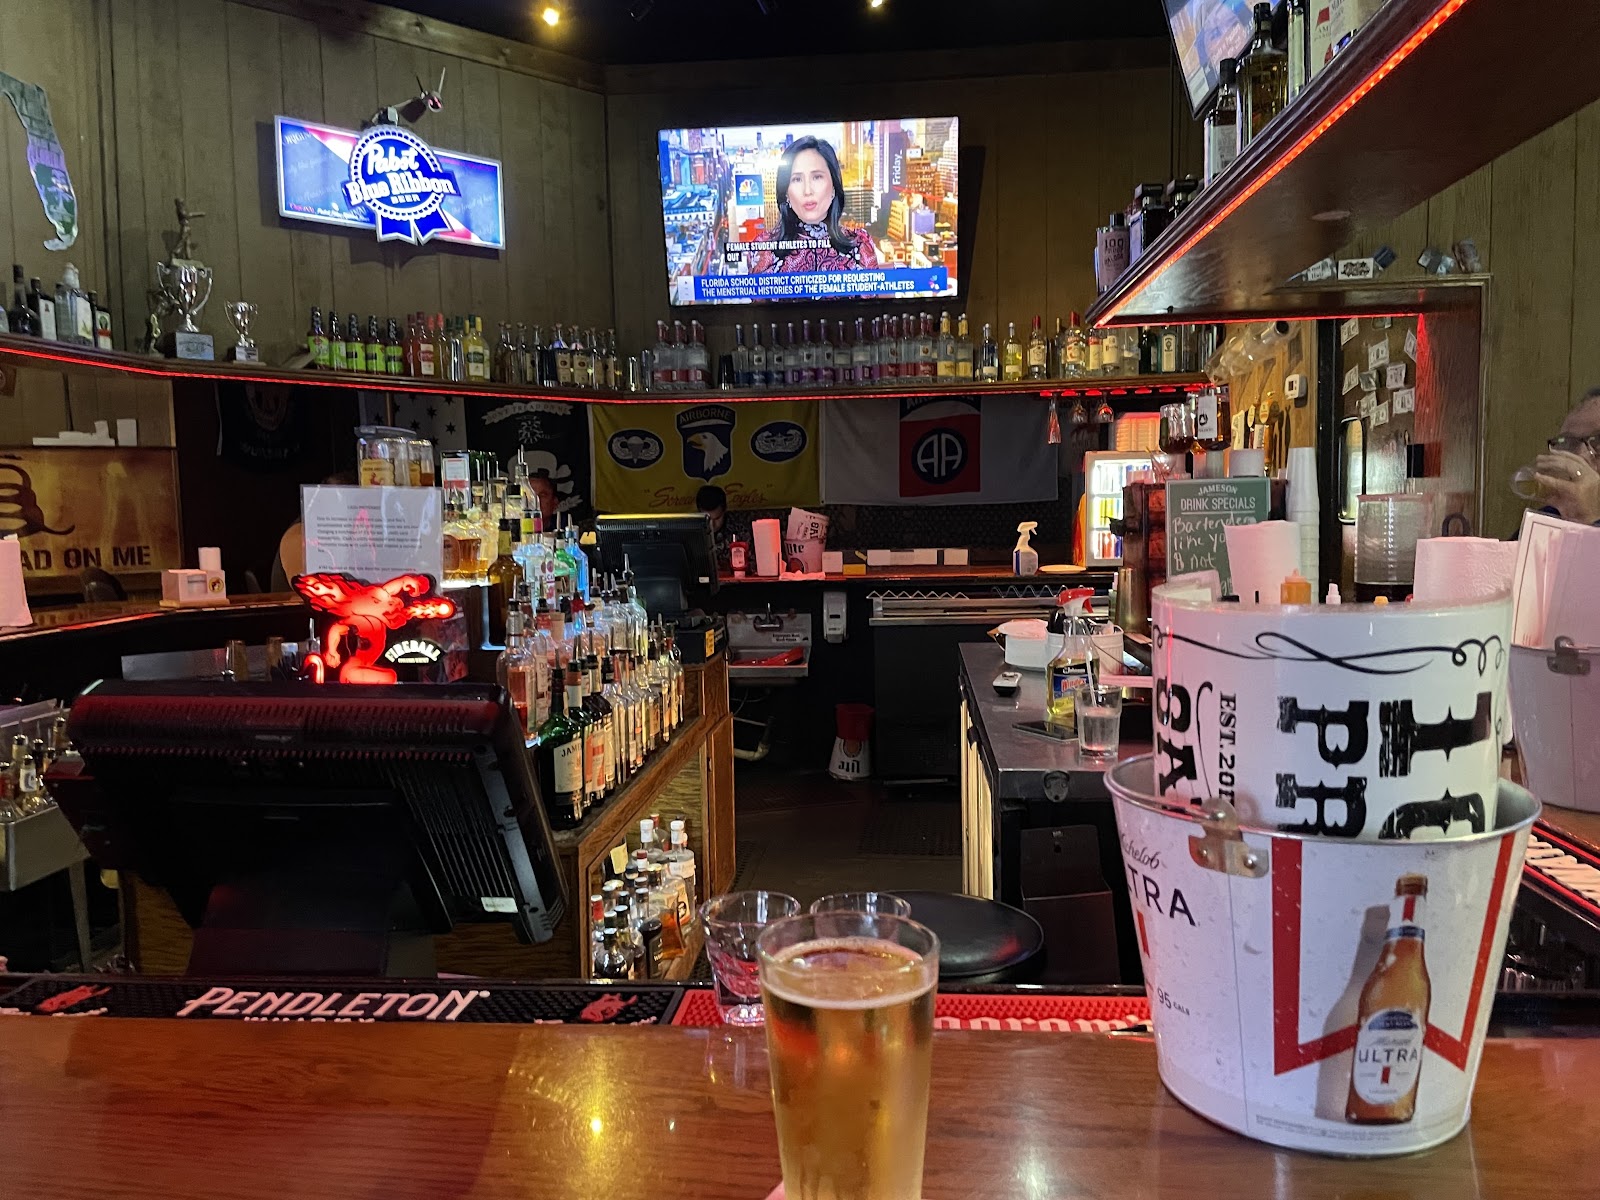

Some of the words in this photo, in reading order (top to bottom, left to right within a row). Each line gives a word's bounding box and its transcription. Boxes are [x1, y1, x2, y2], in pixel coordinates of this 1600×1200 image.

[365, 144, 420, 175] Pabst
[346, 178, 390, 206] Blue
[387, 172, 456, 195] Ribbon
[391, 194, 421, 204] BEER
[726, 242, 750, 251] FEMALE
[751, 241, 778, 250] STUDENT
[779, 240, 808, 249] ATHLETES
[808, 240, 817, 248] TO
[818, 239, 832, 248] FILL
[727, 253, 739, 262] OUT
[701, 278, 729, 288] FLORIDA
[731, 277, 758, 287] SCHOOL
[759, 276, 789, 286] DISTRICT
[790, 275, 827, 285] CRITICIZED
[828, 274, 842, 284] FOR
[843, 272, 886, 283] REQUESTING
[702, 288, 716, 297] THE
[717, 287, 757, 296] MENSTRUAL
[758, 285, 793, 295] HISTORIES
[794, 285, 803, 294] OF
[804, 284, 818, 293] THE
[820, 283, 845, 293] FEMALE
[846, 281, 915, 292] STUDENT-ATHLETES
[679, 407, 732, 424] AIRBORNE
[916, 431, 963, 478] AA
[1198, 484, 1239, 496] JAMESON
[1181, 497, 1210, 511] DRINK
[1212, 496, 1256, 510] SPECIALS
[63, 546, 103, 569] ON
[113, 545, 151, 566] ME
[1190, 552, 1217, 569] not
[177, 986, 480, 1021] PENDLETON
[1157, 986, 1172, 1020] 95
[1358, 1047, 1419, 1063] ULTRA
